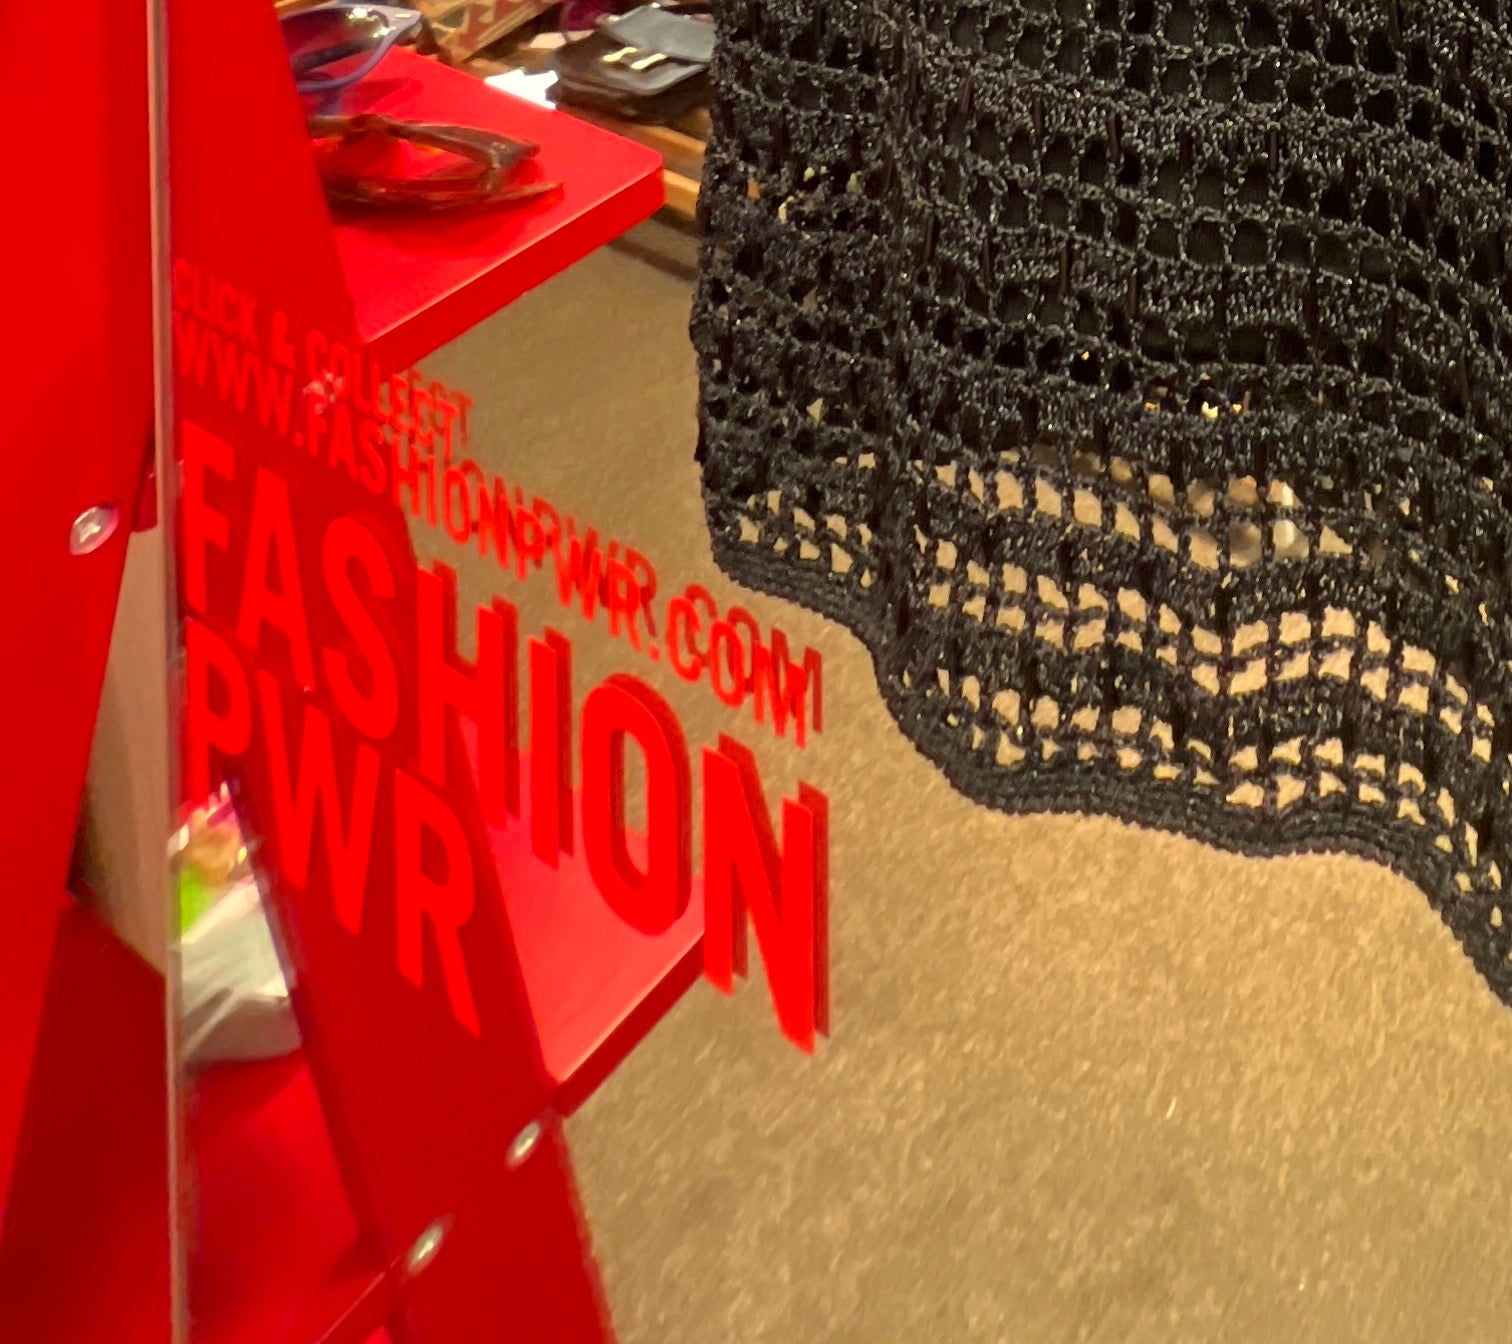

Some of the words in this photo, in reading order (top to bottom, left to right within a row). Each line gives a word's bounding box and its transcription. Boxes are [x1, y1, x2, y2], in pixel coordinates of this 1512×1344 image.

[173, 257, 257, 349] CLICK
[271, 310, 295, 370] &
[306, 329, 462, 460] COLLECT
[174, 310, 807, 749] WWW.FASHIONPWR.COM
[182, 418, 815, 1055] FASHION
[185, 616, 481, 1038] PWR
